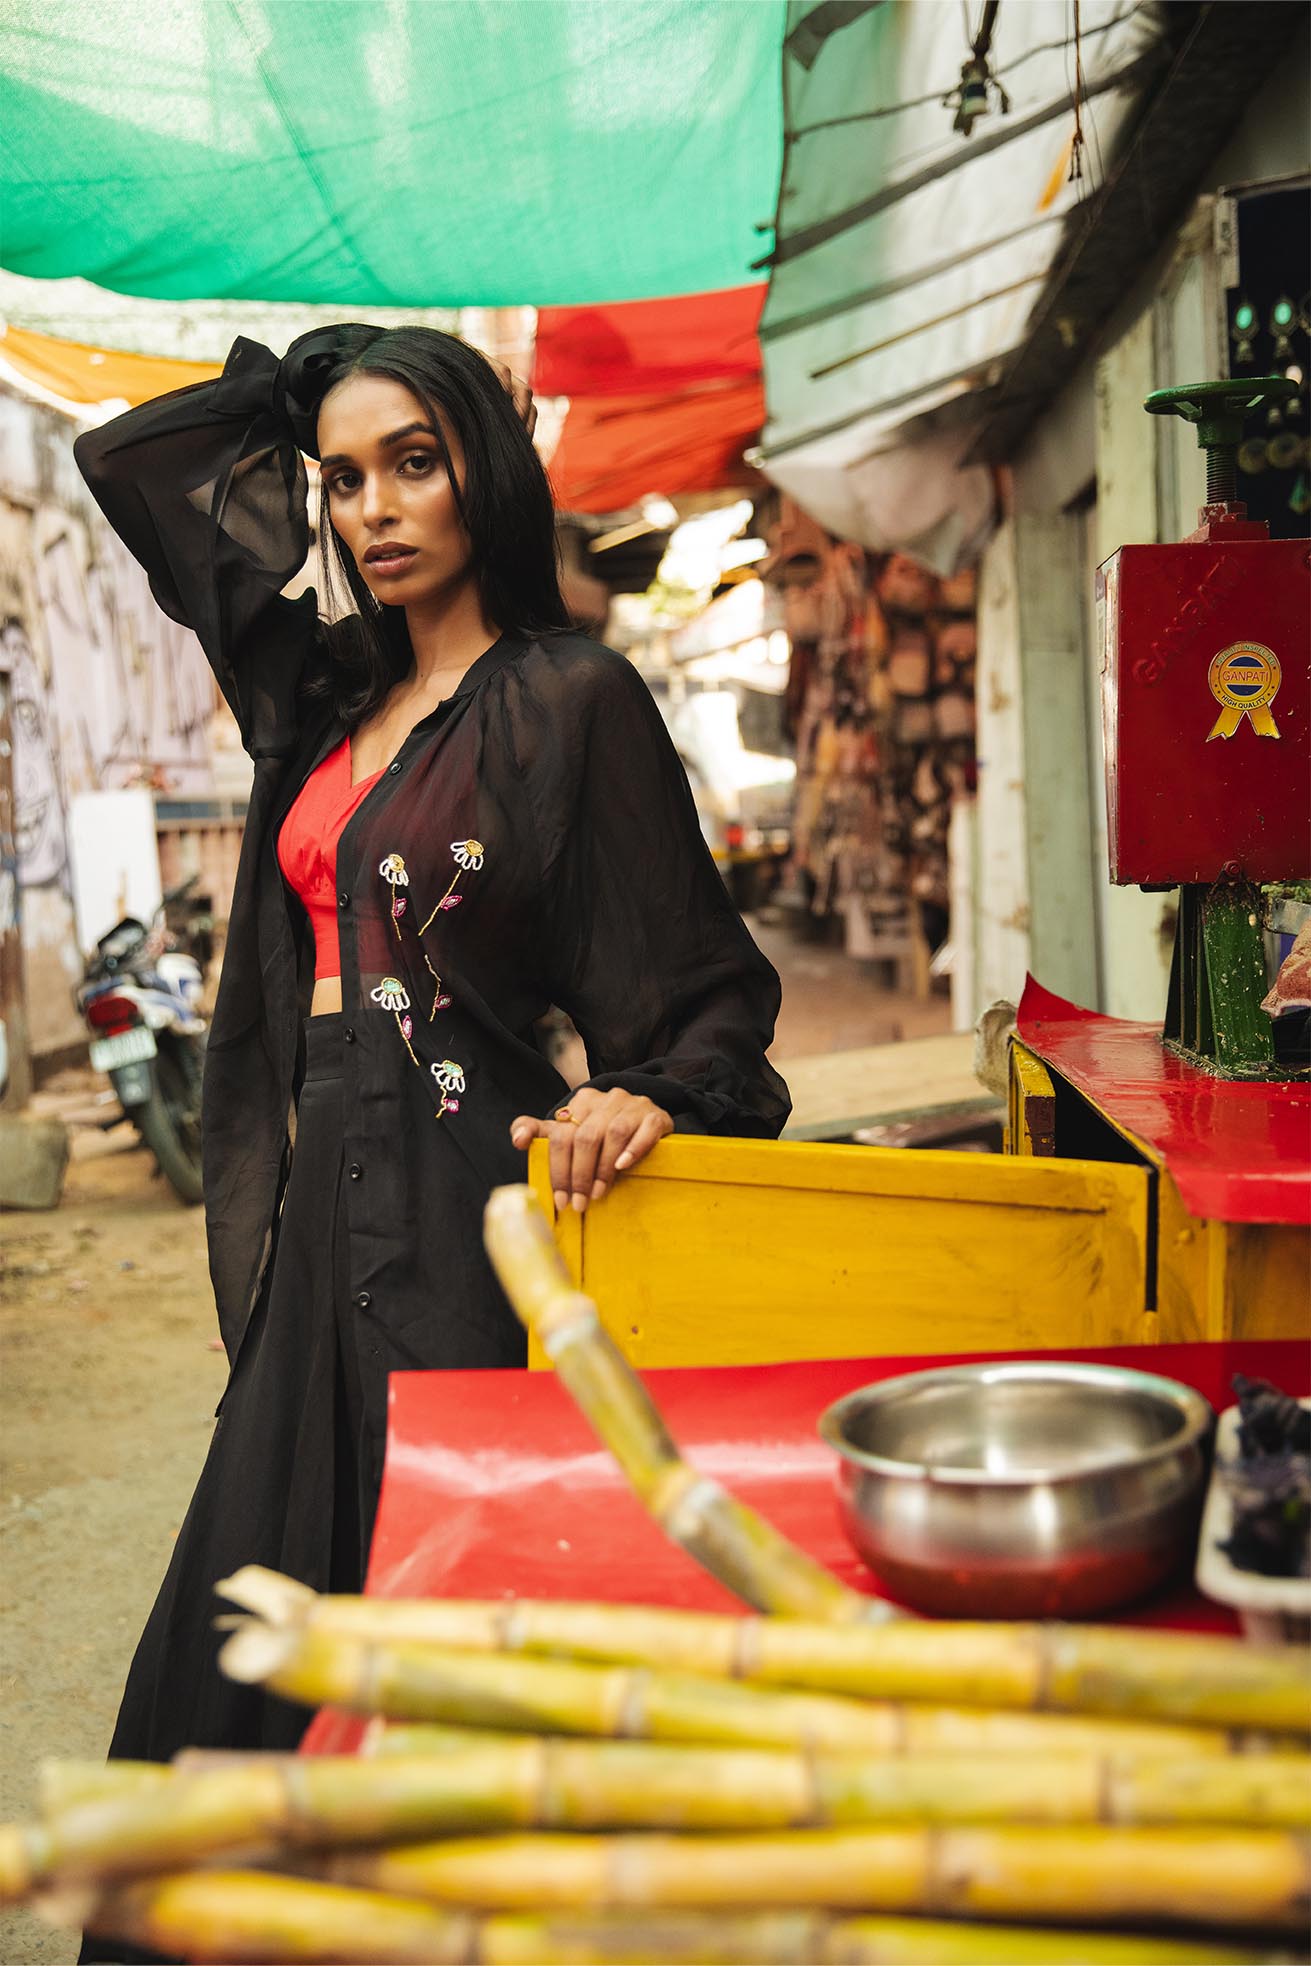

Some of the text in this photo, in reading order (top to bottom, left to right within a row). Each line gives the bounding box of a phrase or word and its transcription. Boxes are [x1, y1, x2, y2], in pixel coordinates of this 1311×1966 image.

[1244, 645, 1276, 666] INSPECTED
[1222, 670, 1269, 682] GANPATI
[1221, 695, 1266, 709] HIGH QUALITY
